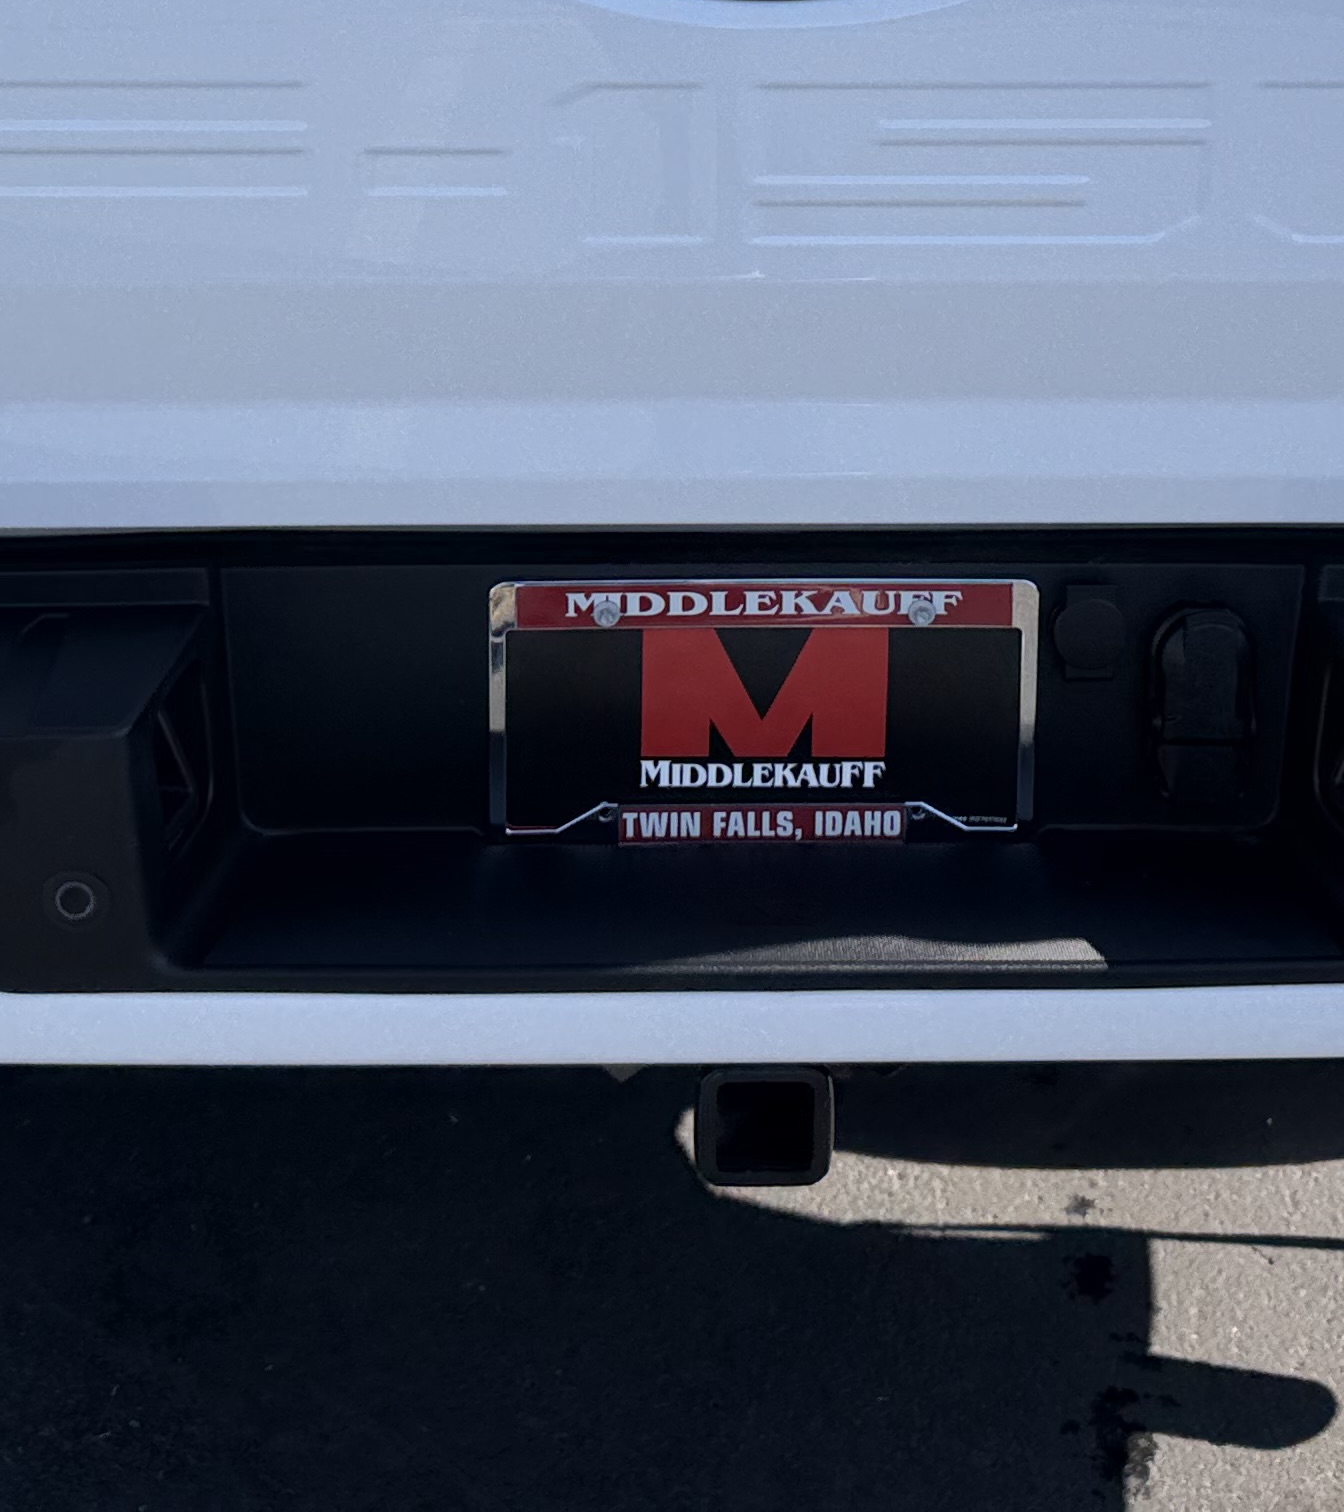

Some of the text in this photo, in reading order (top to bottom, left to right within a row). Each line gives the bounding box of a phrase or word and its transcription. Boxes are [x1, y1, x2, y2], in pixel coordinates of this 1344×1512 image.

[565, 590, 963, 618] MIDDLEKAUFF
[641, 628, 889, 757] M
[640, 759, 886, 788] MIDDLEKAUFF
[622, 809, 902, 840] TWIN FALLS, IDAHO
